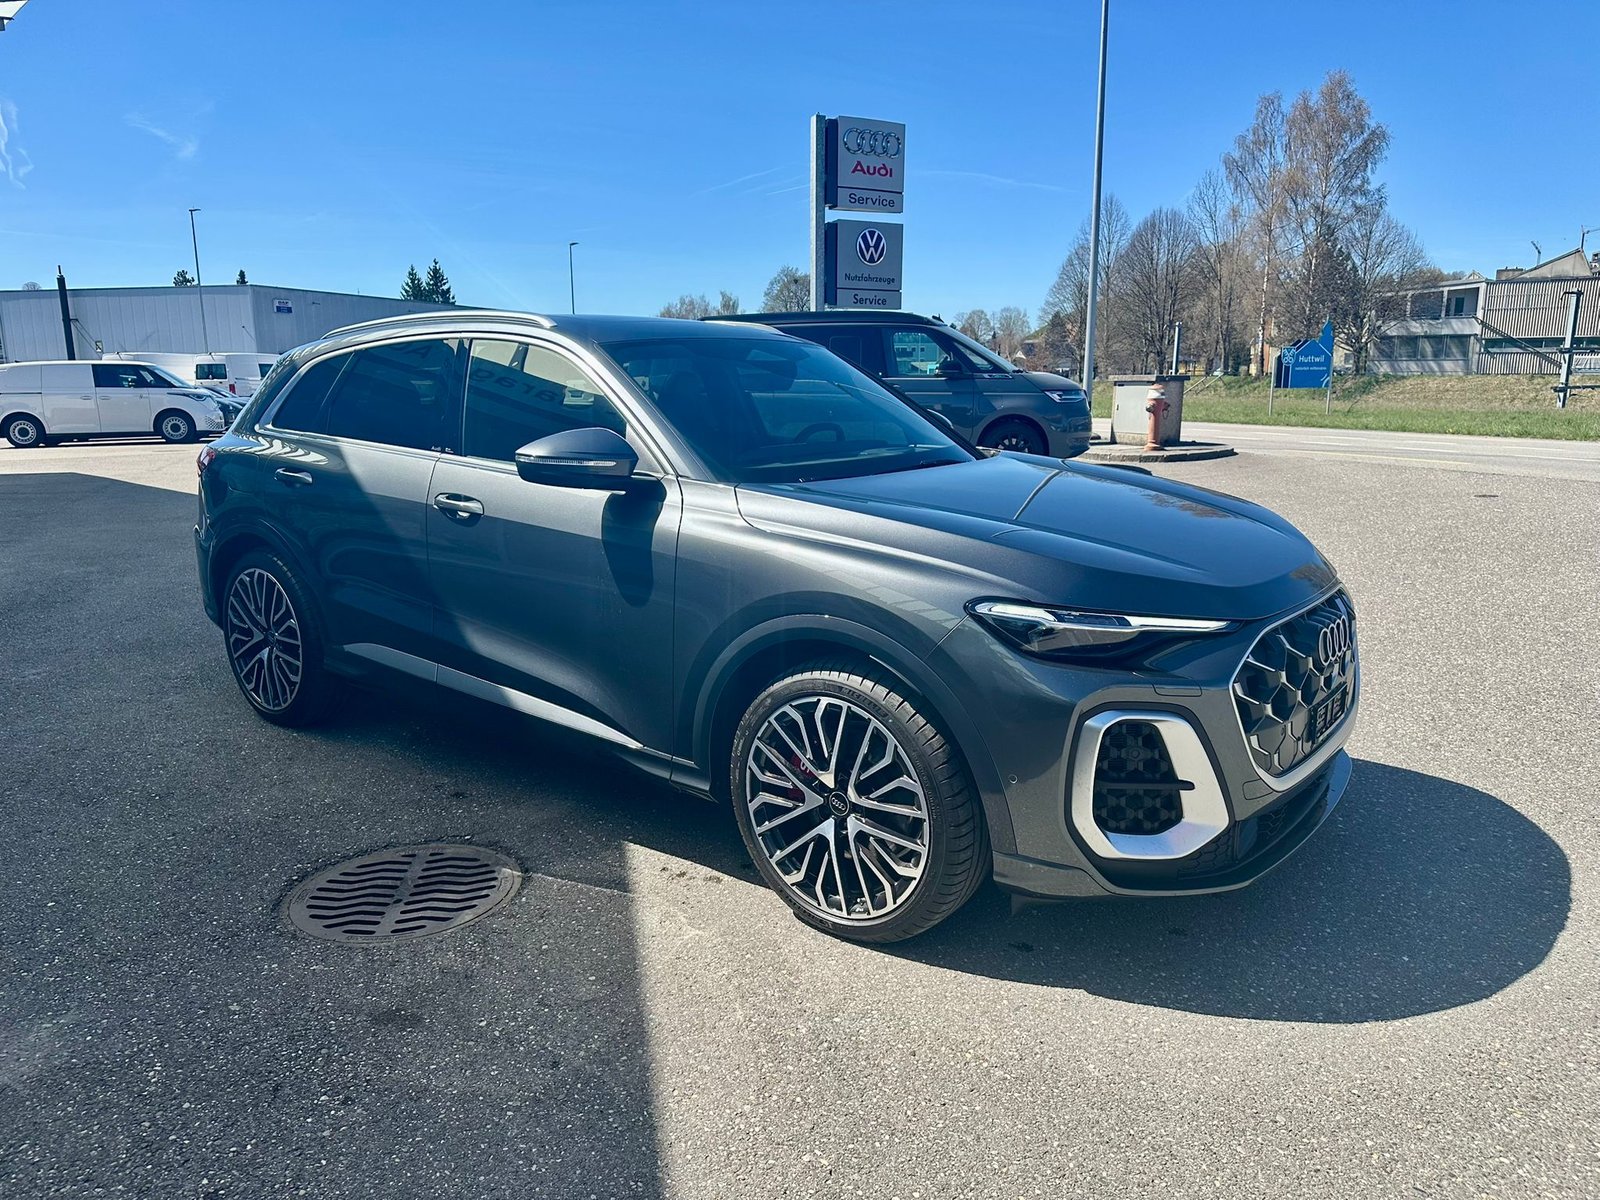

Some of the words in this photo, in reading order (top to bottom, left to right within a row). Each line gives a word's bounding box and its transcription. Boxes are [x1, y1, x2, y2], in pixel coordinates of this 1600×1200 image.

[851, 160, 893, 178] Audi
[848, 192, 895, 208] Service
[844, 272, 896, 285] Nutzfahrzeuge
[852, 293, 888, 306] Service
[1298, 354, 1325, 363] Huttwil
